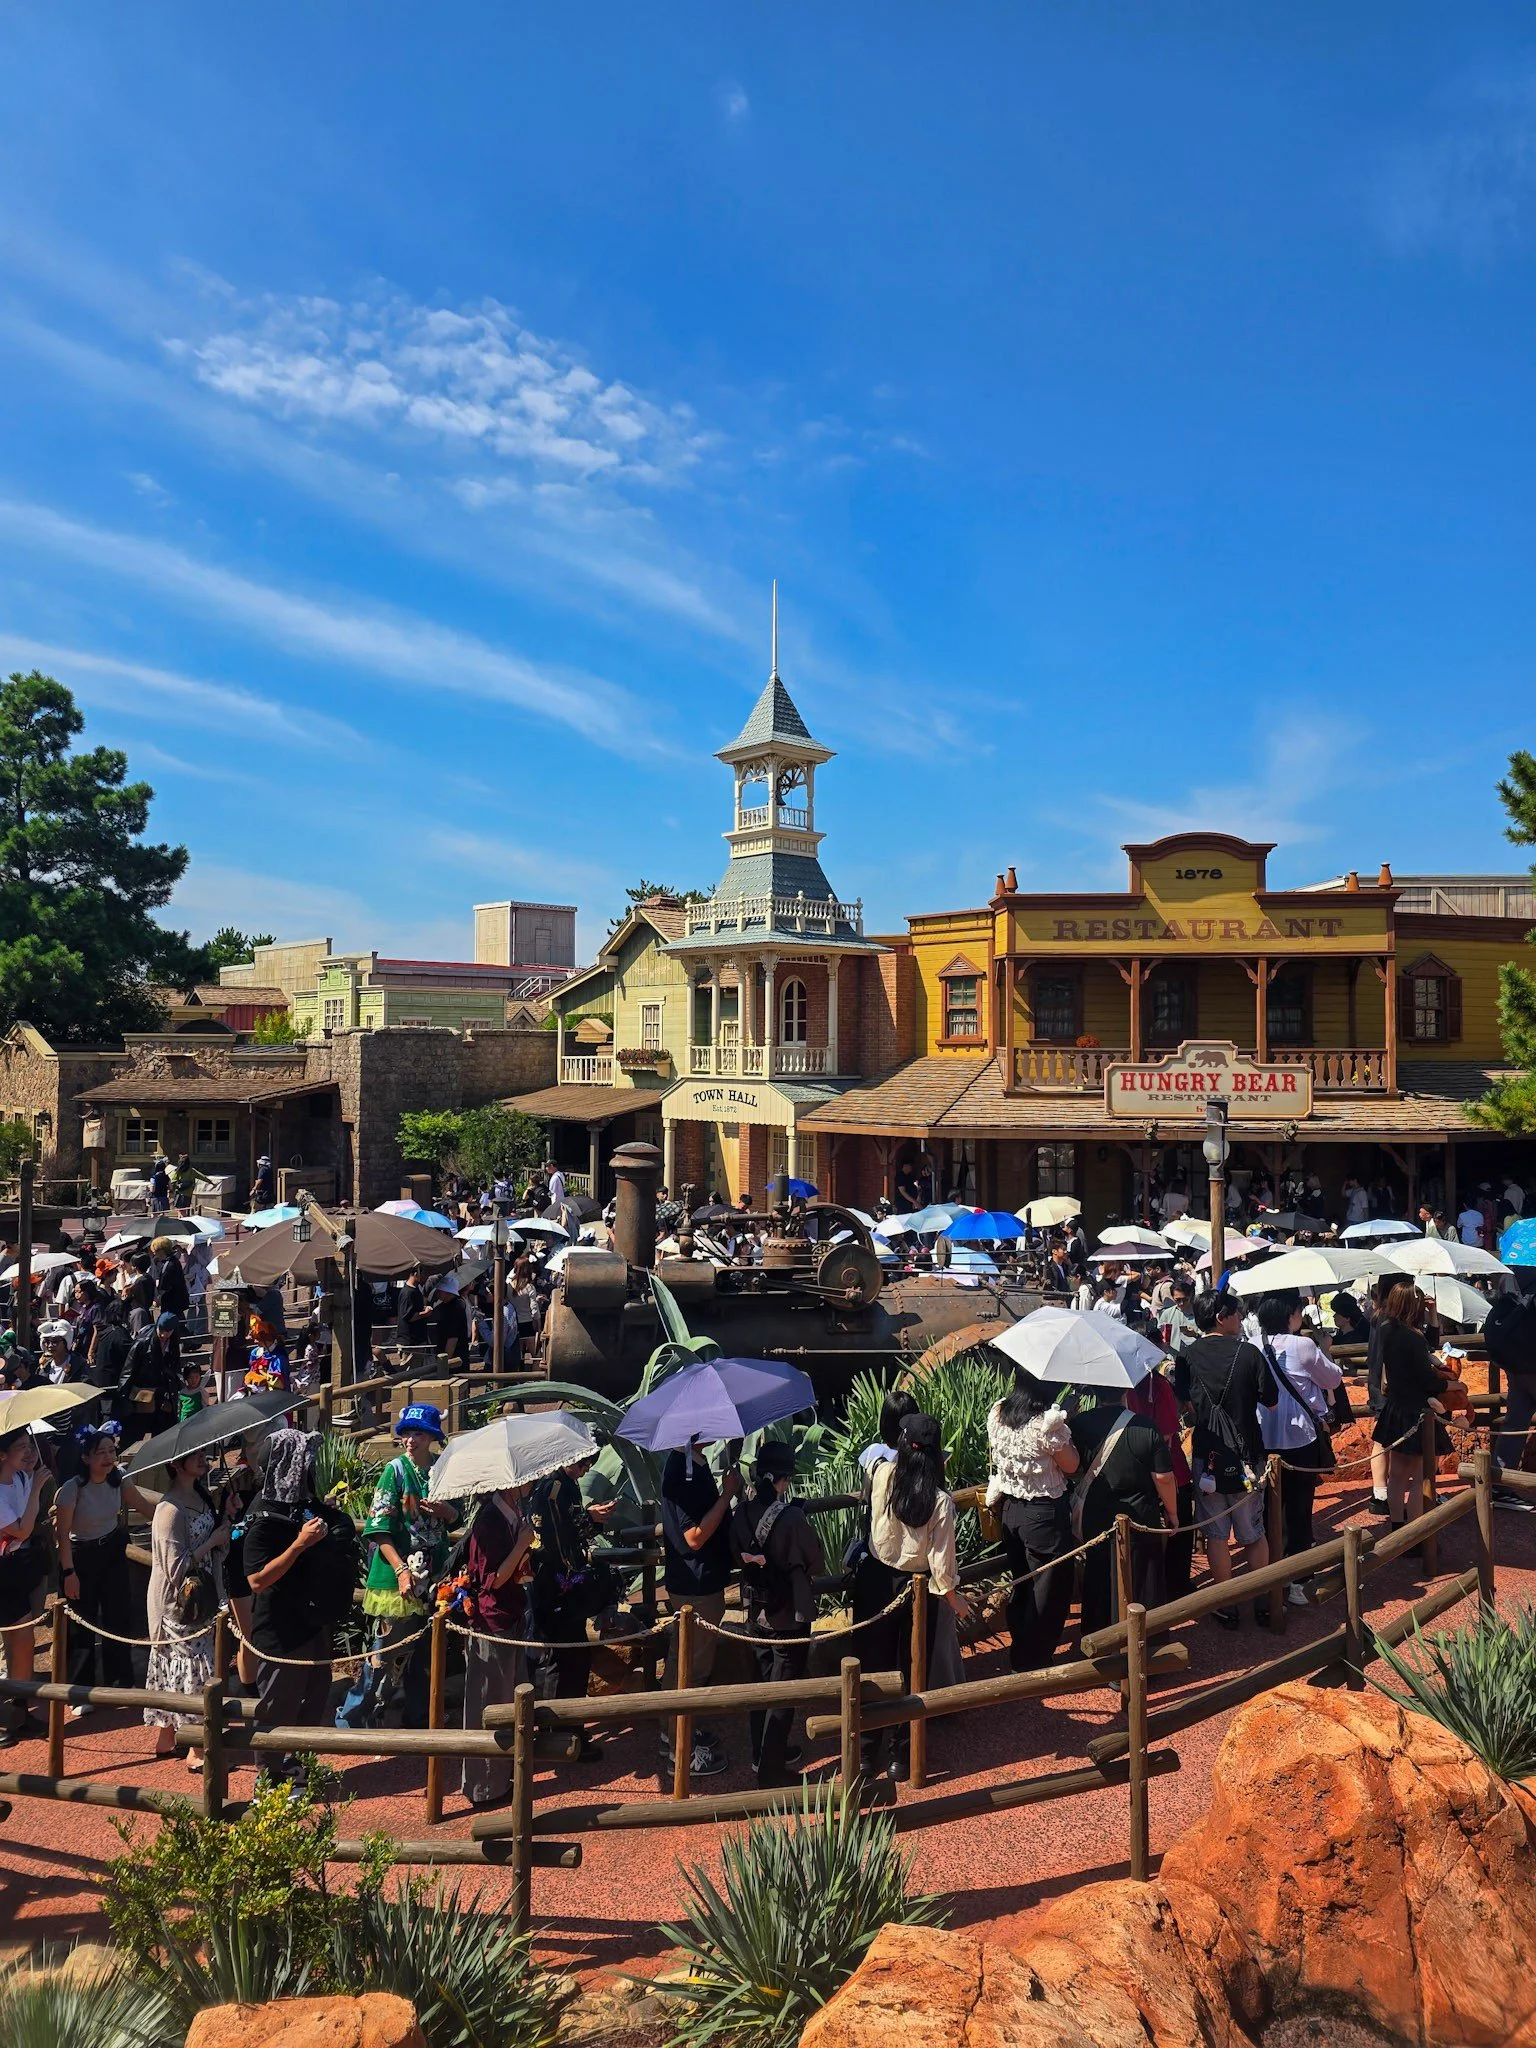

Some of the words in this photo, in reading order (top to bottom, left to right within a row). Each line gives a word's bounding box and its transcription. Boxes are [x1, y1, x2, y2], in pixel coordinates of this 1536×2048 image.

[1052, 918, 1343, 942] RESTAURANT
[1120, 1072, 1222, 1092] HUNGRY
[1232, 1073, 1297, 1093] BEAR
[693, 1088, 724, 1104] TOWN
[728, 1089, 758, 1107] HALL
